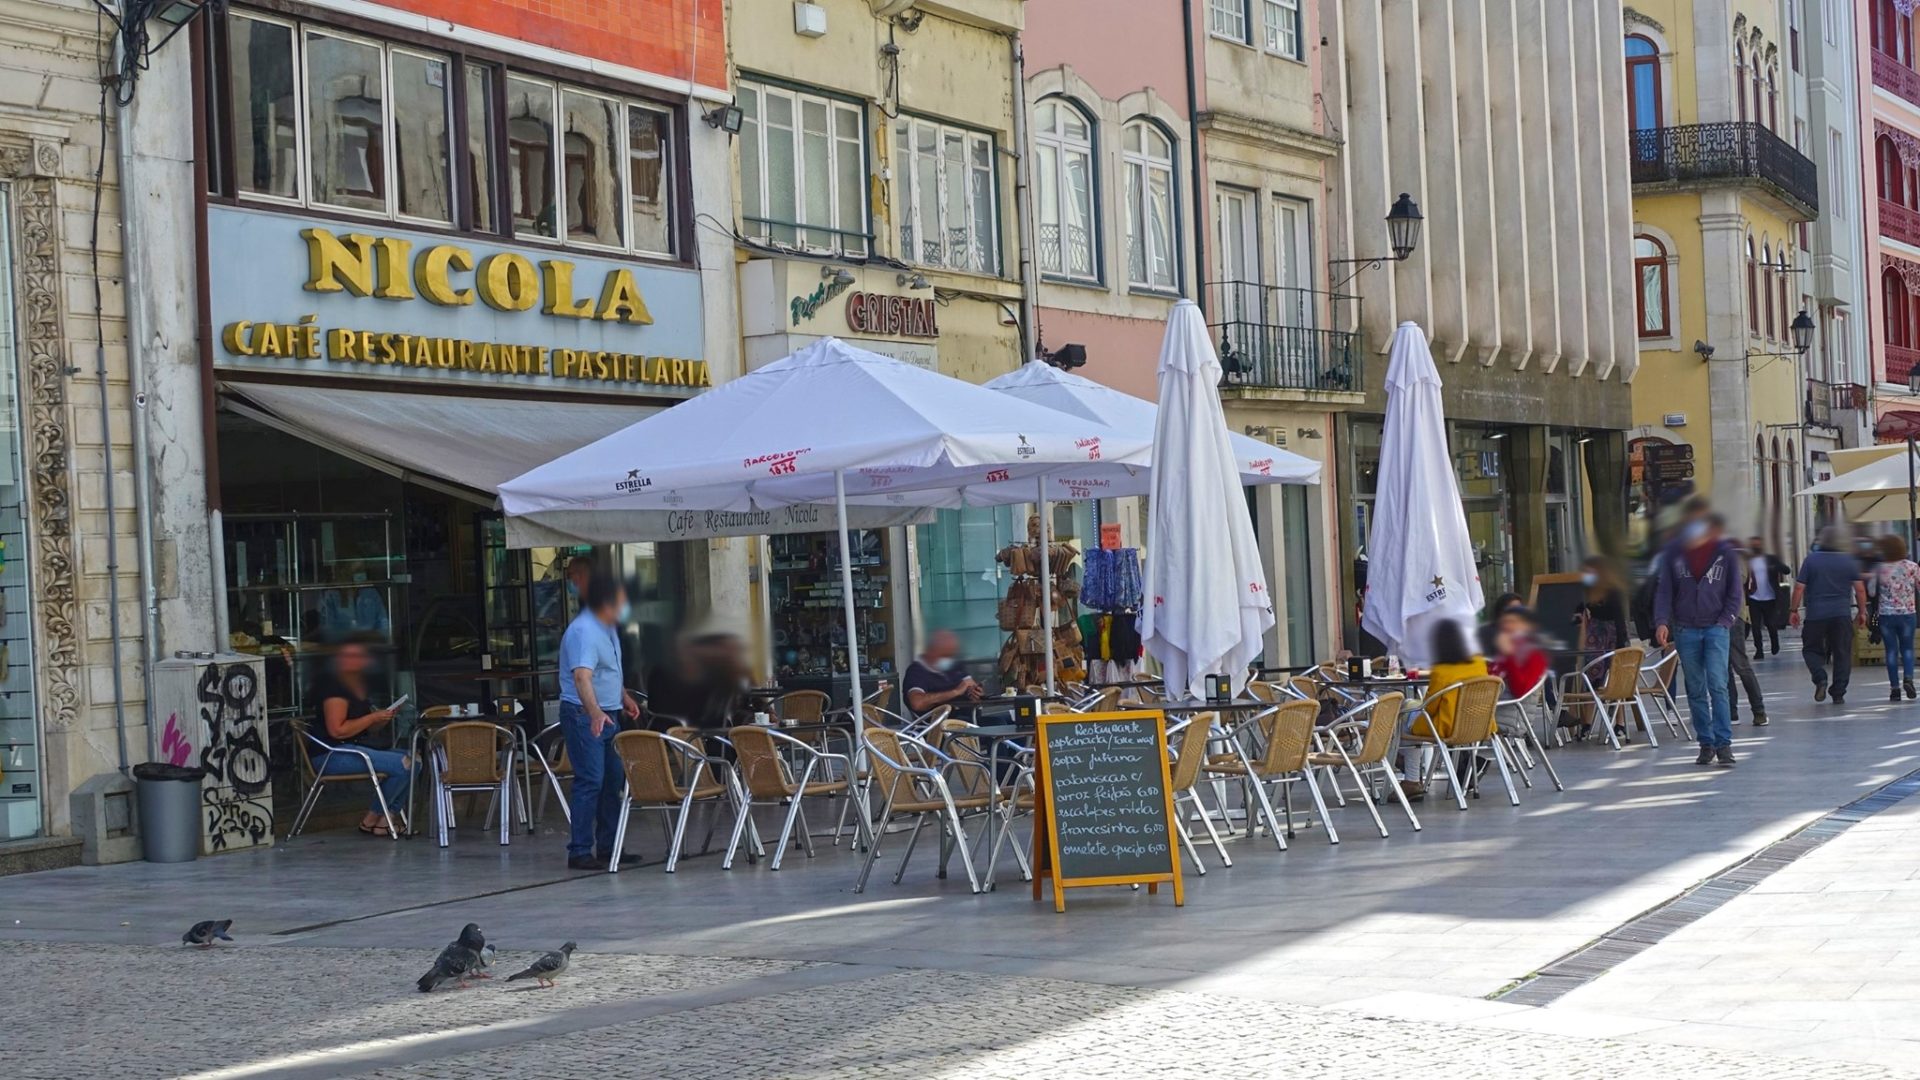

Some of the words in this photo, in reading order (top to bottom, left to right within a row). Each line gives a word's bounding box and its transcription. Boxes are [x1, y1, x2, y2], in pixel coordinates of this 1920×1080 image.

[300, 228, 654, 325] NICOLA
[846, 291, 940, 337] CRISTAL
[223, 313, 321, 359] CAFÉ
[328, 328, 549, 375] RESTAURANTE
[552, 349, 713, 387] PASTELARIA
[1017, 447, 1036, 455] ESTRELLA
[769, 461, 796, 475] 1876
[986, 471, 1009, 483] 1876
[616, 478, 652, 490] ESTRELLA
[668, 509, 694, 536] Café
[704, 509, 771, 532] Restaurante
[785, 503, 818, 525] Nicola
[1052, 755, 1082, 770] sopa
[1089, 748, 1142, 770] juliana
[1055, 773, 1128, 791] pataniscas
[1057, 791, 1091, 802] arroz
[1061, 821, 1139, 841] francesinha
[1112, 840, 1146, 860] queijo
